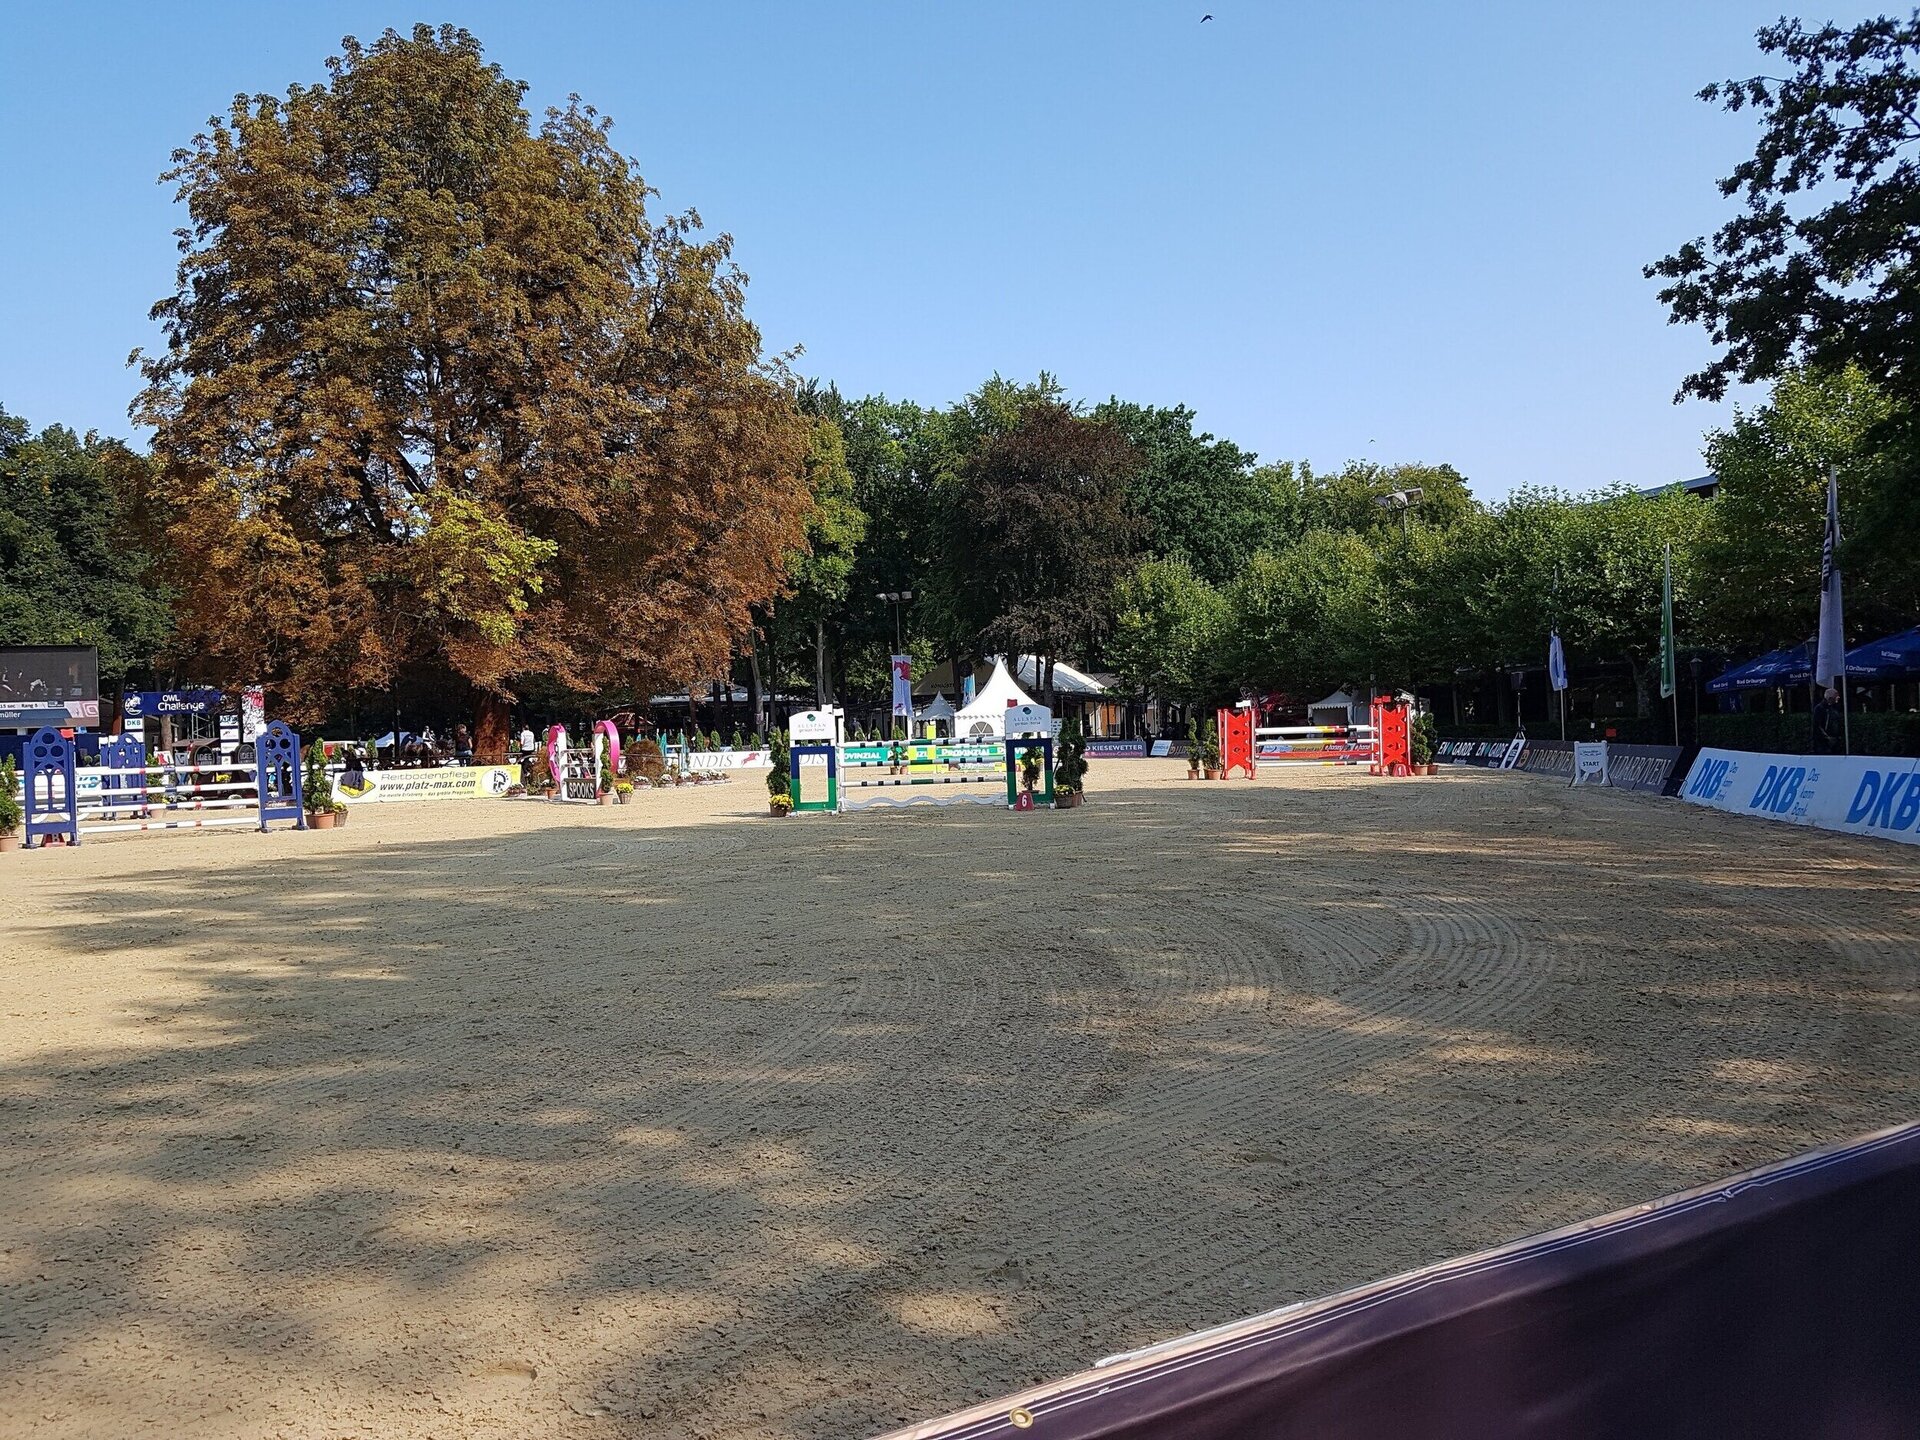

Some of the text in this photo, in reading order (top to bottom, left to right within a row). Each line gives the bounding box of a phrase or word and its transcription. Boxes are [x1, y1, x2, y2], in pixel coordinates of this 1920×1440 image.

[157, 702, 205, 711] Challenge
[240, 752, 254, 760] IDEE
[942, 748, 989, 757] PROVINZIAL
[1437, 742, 1475, 757] EN GARDE
[1476, 743, 1488, 757] EN
[197, 753, 212, 761] IDEE
[381, 771, 477, 782] Reitbodenpflege
[1689, 758, 1730, 800] DKB
[1807, 767, 1820, 782] Das
[379, 780, 476, 792] www.platz-max.com
[568, 782, 595, 798] SPOOKS
[1749, 765, 1806, 814] DKB
[1021, 794, 1028, 808] 6
[1845, 770, 1920, 831] DKB
